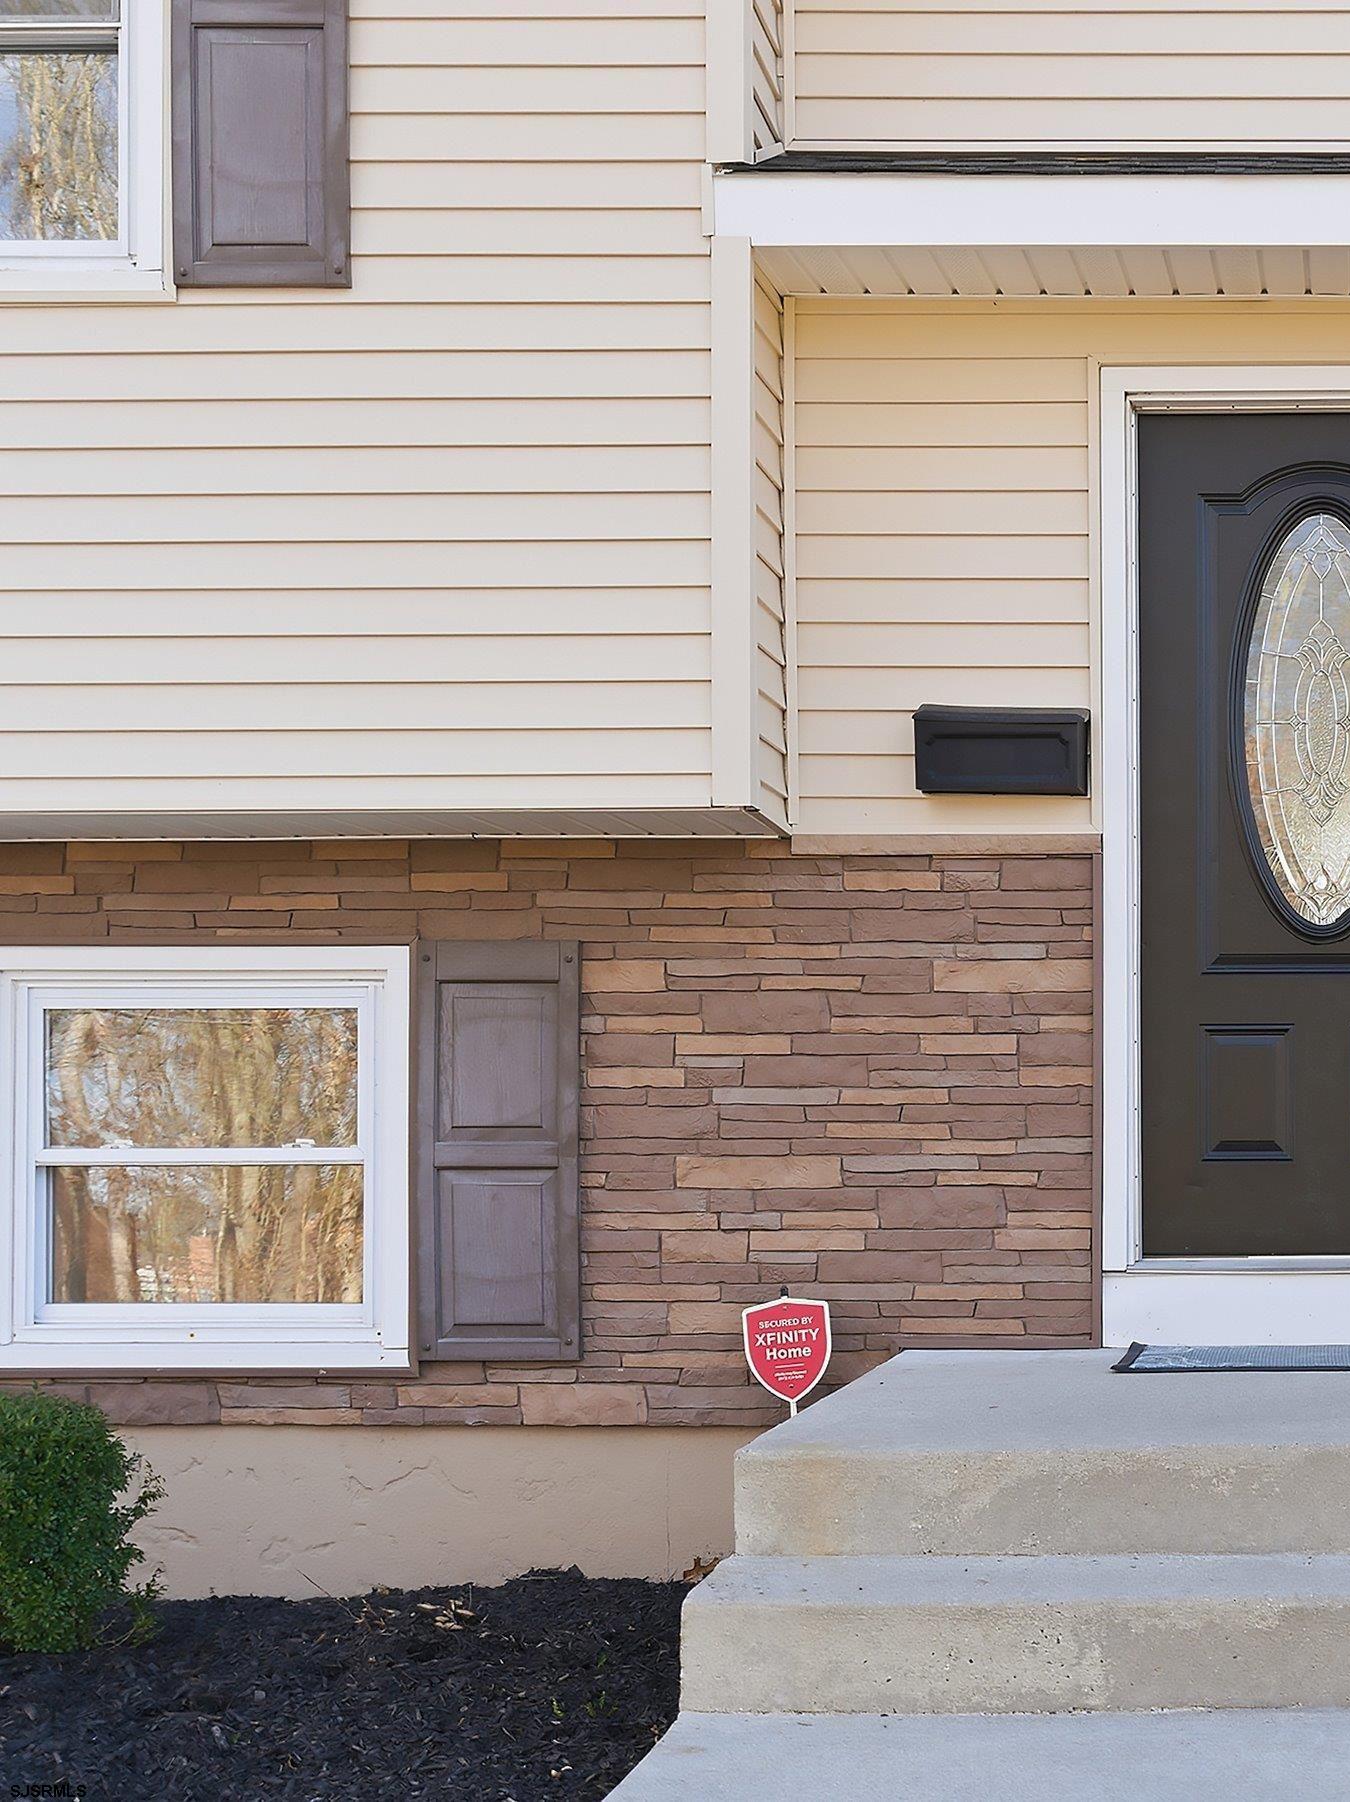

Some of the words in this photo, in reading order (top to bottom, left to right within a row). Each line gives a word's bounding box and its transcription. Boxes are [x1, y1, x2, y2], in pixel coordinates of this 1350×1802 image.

[759, 1318, 799, 1329] SECURED
[801, 1316, 813, 1325] BY
[755, 1328, 820, 1347] XFINITY
[765, 1346, 812, 1360] Home
